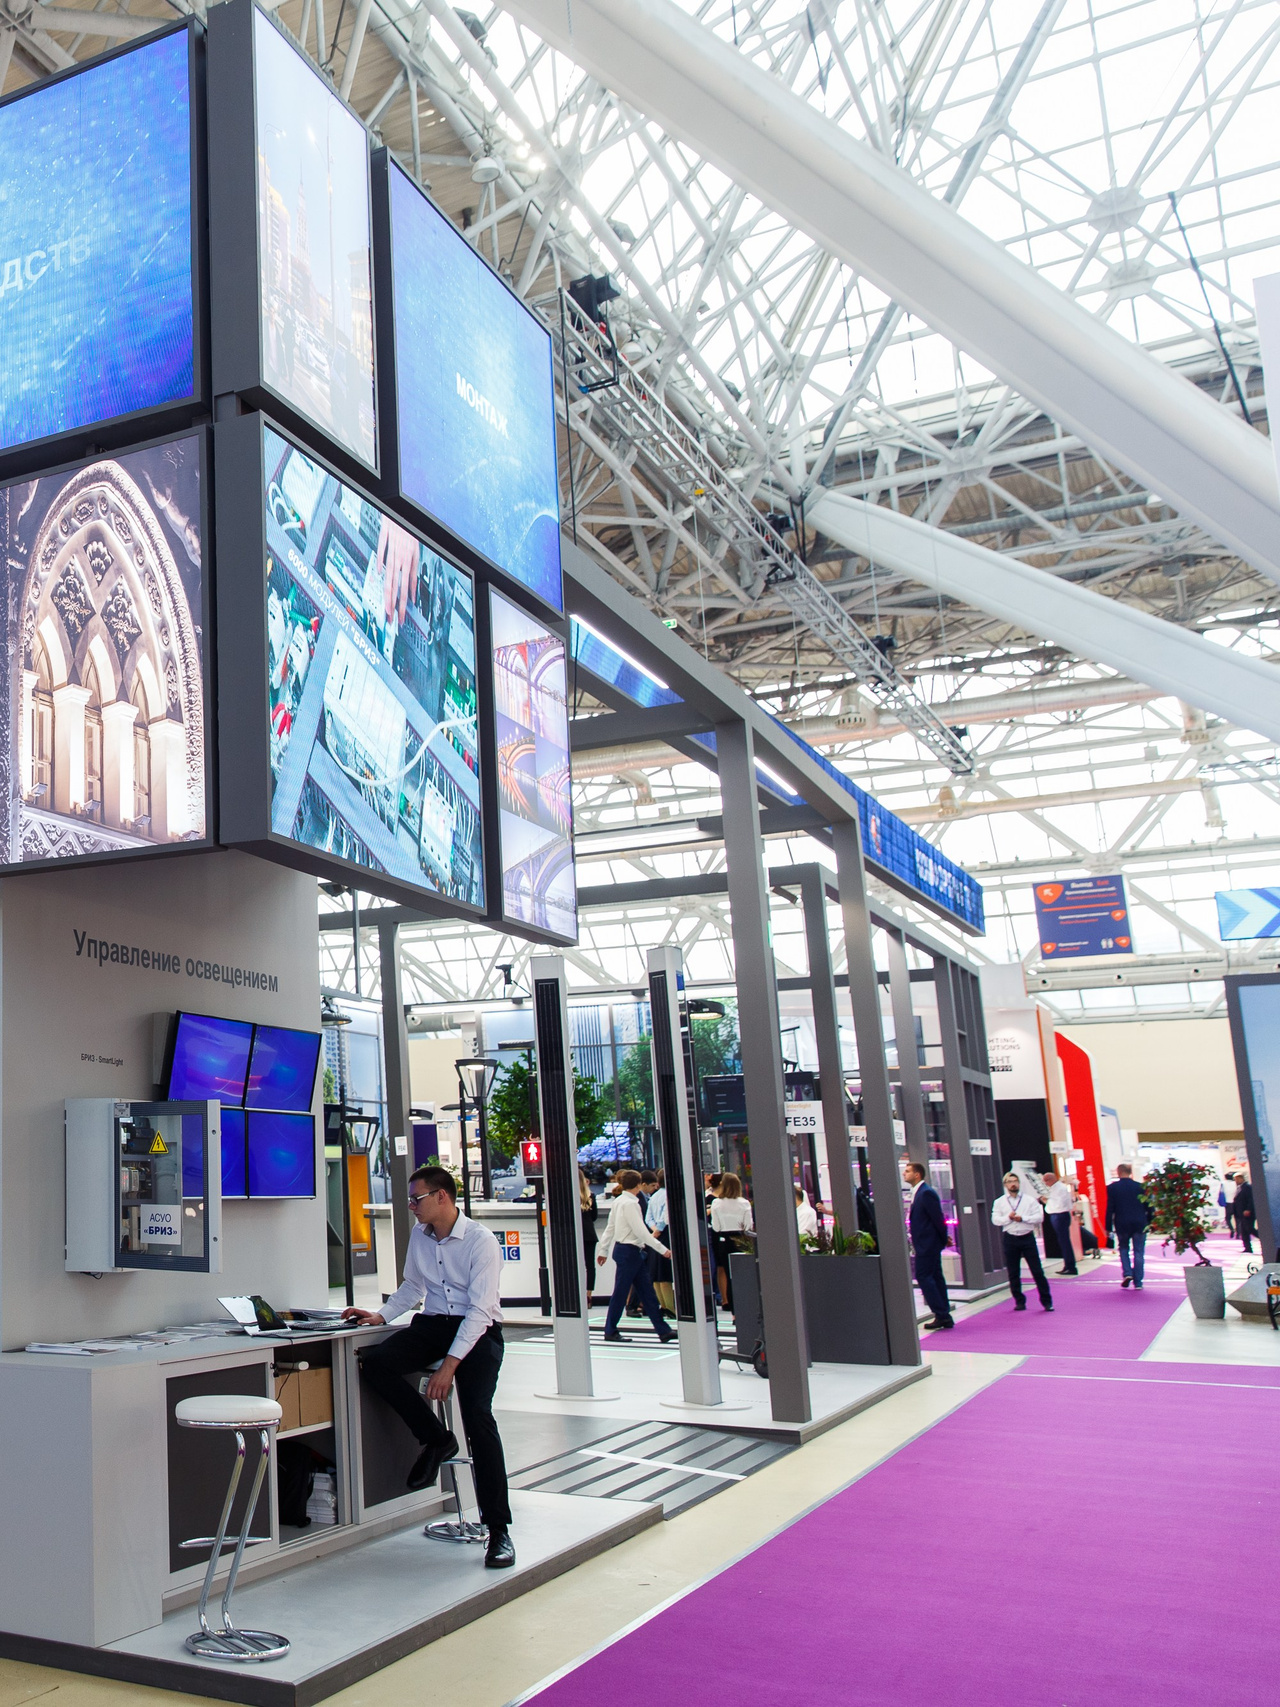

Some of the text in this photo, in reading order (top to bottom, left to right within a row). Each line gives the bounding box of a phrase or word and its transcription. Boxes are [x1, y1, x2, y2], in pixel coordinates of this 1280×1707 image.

[455, 371, 510, 440] МОНТАЖ
[308, 573, 350, 632] МОДУЛЕЙ
[73, 929, 279, 993] Управление освещением
[80, 1053, 95, 1062] БРИЗ
[98, 1054, 124, 1067] SmartLight
[785, 1116, 816, 1127] FE35
[149, 1212, 172, 1223] АСУО
[143, 1226, 178, 1236] «БРИЗ»
